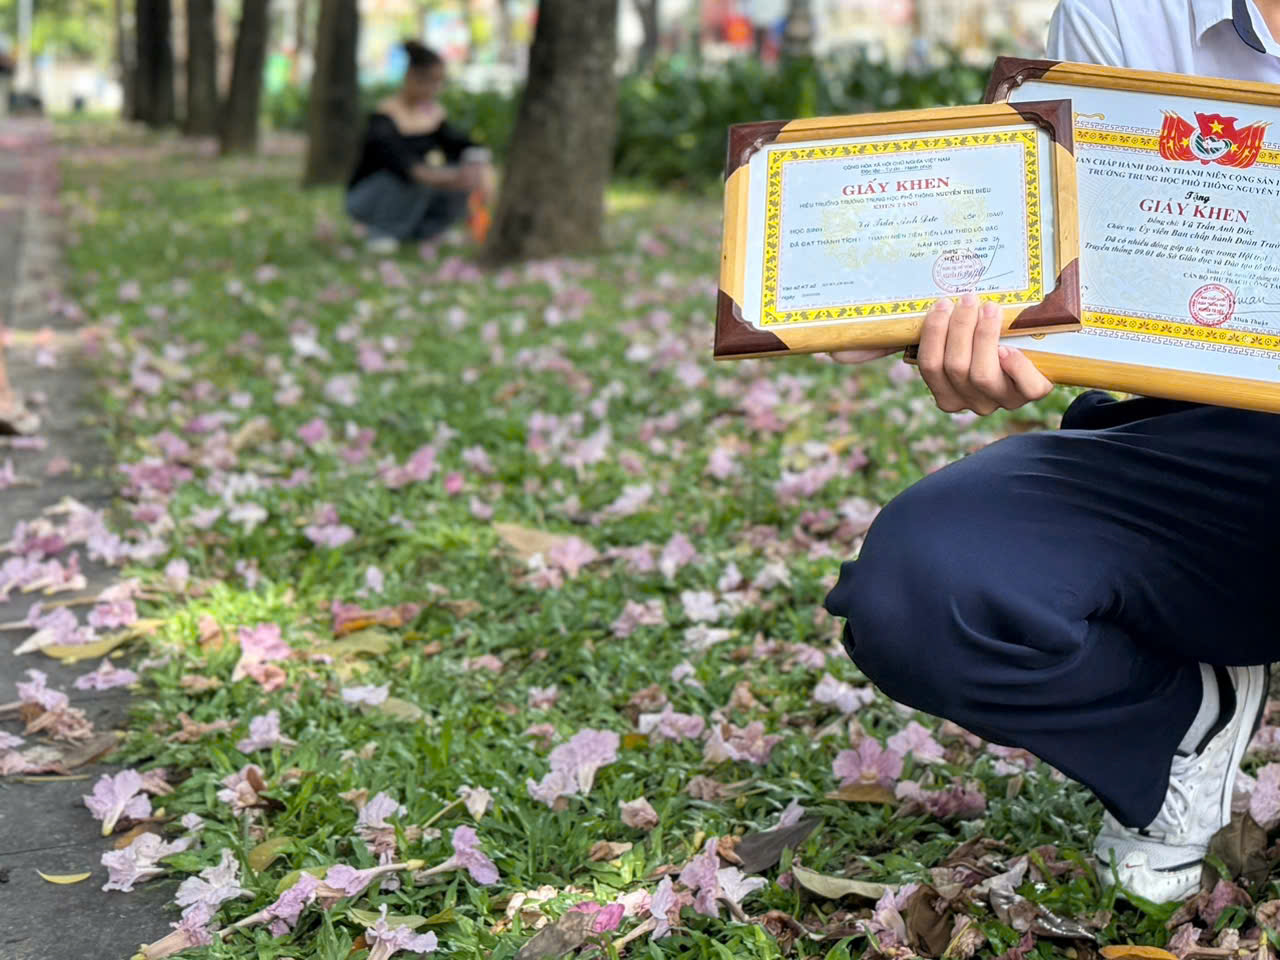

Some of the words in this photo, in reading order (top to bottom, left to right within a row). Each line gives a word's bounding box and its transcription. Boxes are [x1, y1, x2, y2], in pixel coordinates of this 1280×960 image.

[1173, 167, 1204, 177] THANH
[1128, 172, 1158, 183] TRUNG
[1160, 177, 1180, 185] HỌC
[842, 178, 889, 196] GIẤY
[897, 177, 950, 192] KHEN
[1140, 198, 1189, 216] GIẤY
[1193, 205, 1249, 223] KHEN
[1171, 230, 1189, 238] Ban
[1218, 225, 1234, 233] Anh
